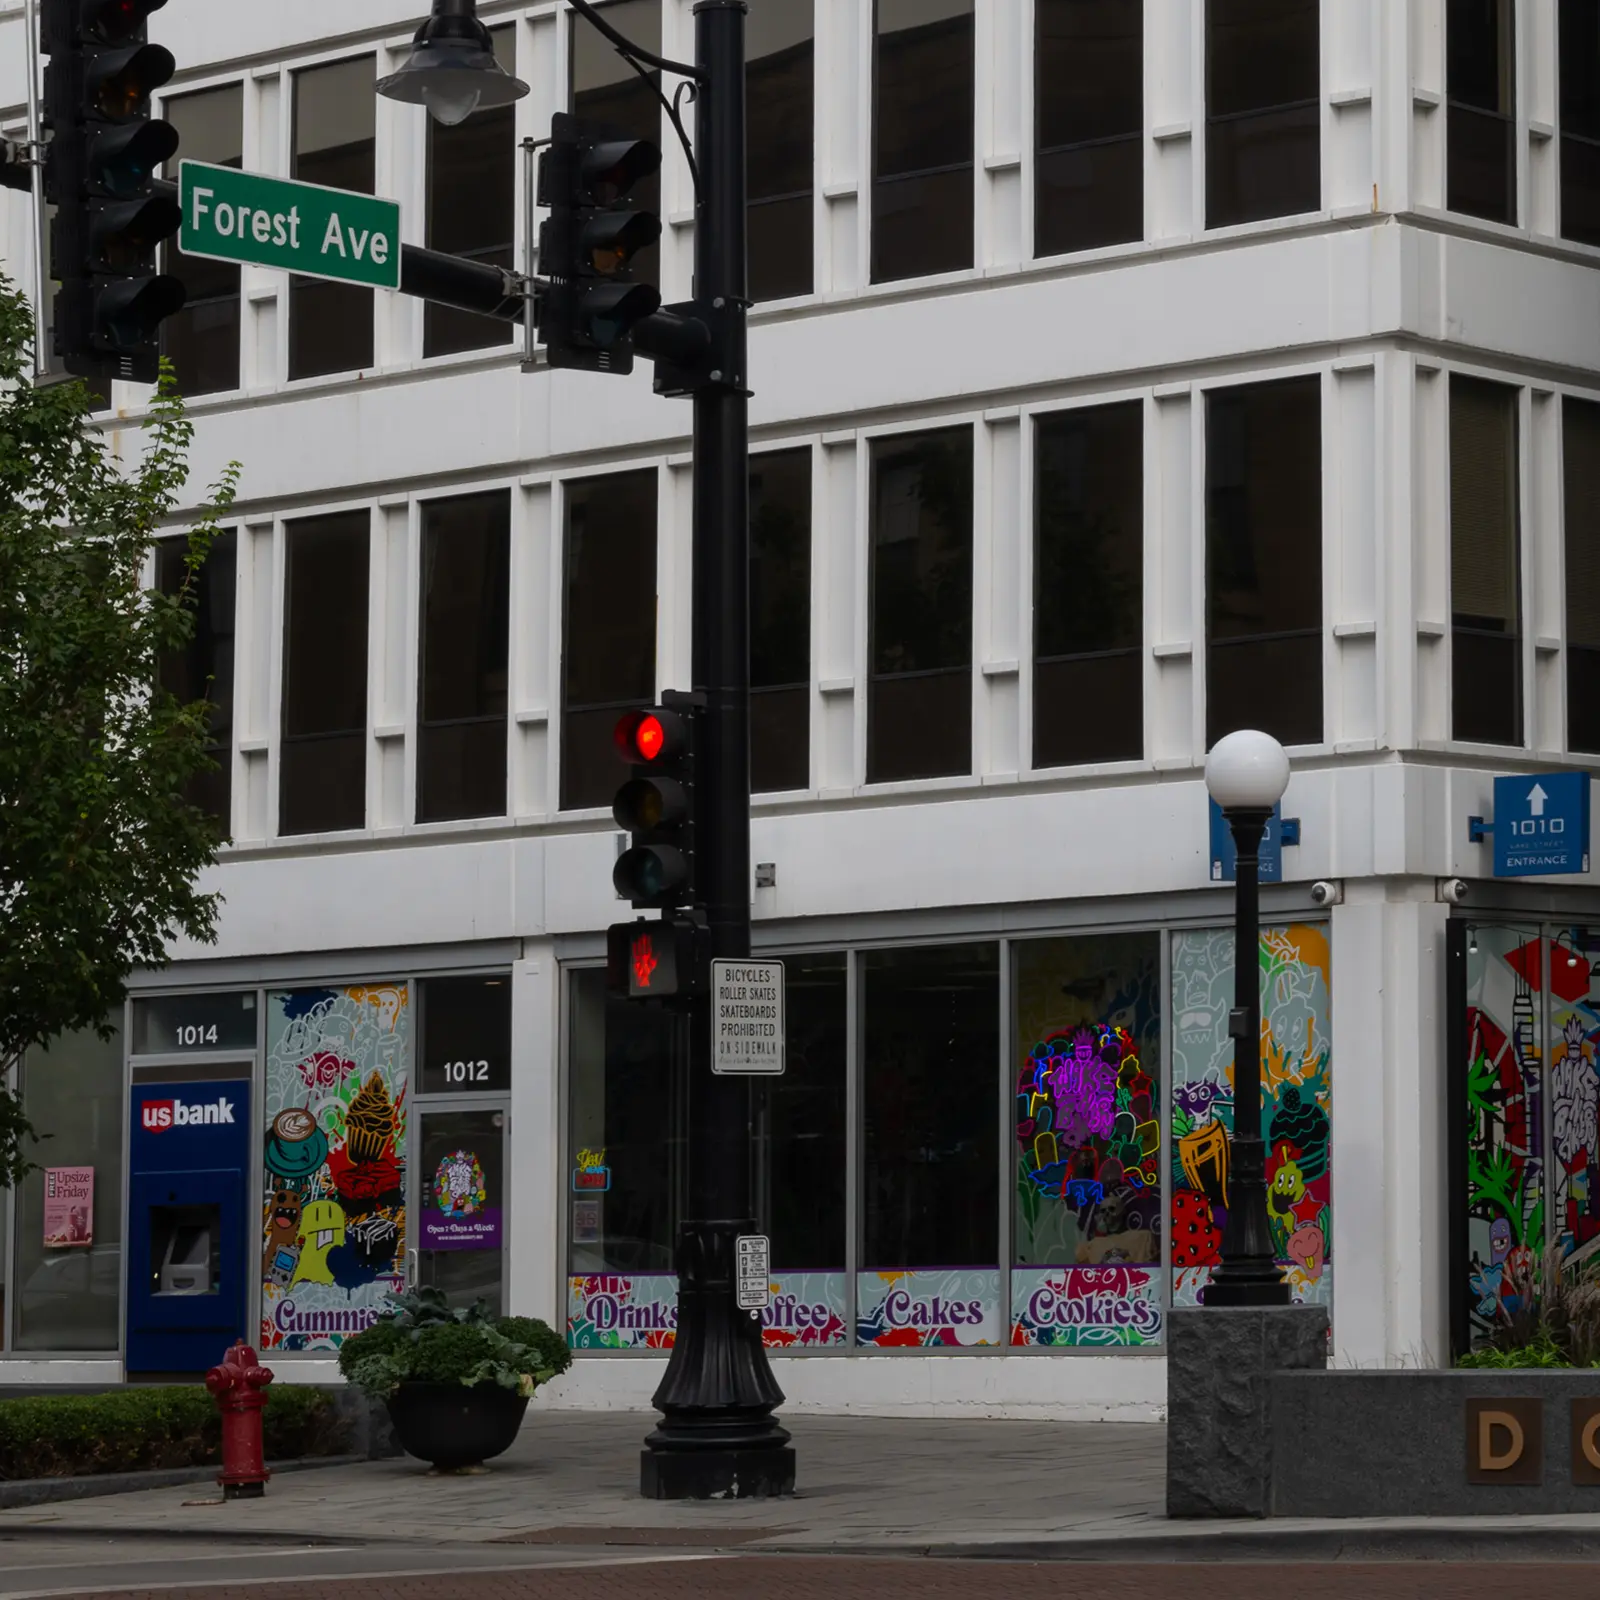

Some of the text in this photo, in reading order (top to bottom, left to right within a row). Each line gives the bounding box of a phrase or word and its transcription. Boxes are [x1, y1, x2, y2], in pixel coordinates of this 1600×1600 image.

[192, 186, 389, 265] Forest Ave
[1510, 818, 1564, 836] 1010
[1506, 855, 1568, 868] ENTRANCE
[720, 986, 777, 1001] ROLLER SKATES
[720, 1004, 777, 1019] SKATEBOARDS
[176, 1025, 218, 1046] 1014
[721, 1023, 776, 1037] PROHIBITED
[720, 1040, 777, 1055] ON SIDEWALK
[444, 1060, 490, 1083] 1012
[57, 1171, 90, 1186] Upsize
[56, 1185, 90, 1200] Friday
[275, 1298, 385, 1333] Gummie
[585, 1294, 679, 1331] Drinks
[761, 1294, 830, 1329] offee
[885, 1288, 984, 1326] Cakes
[1029, 1288, 1150, 1326] Cookies
